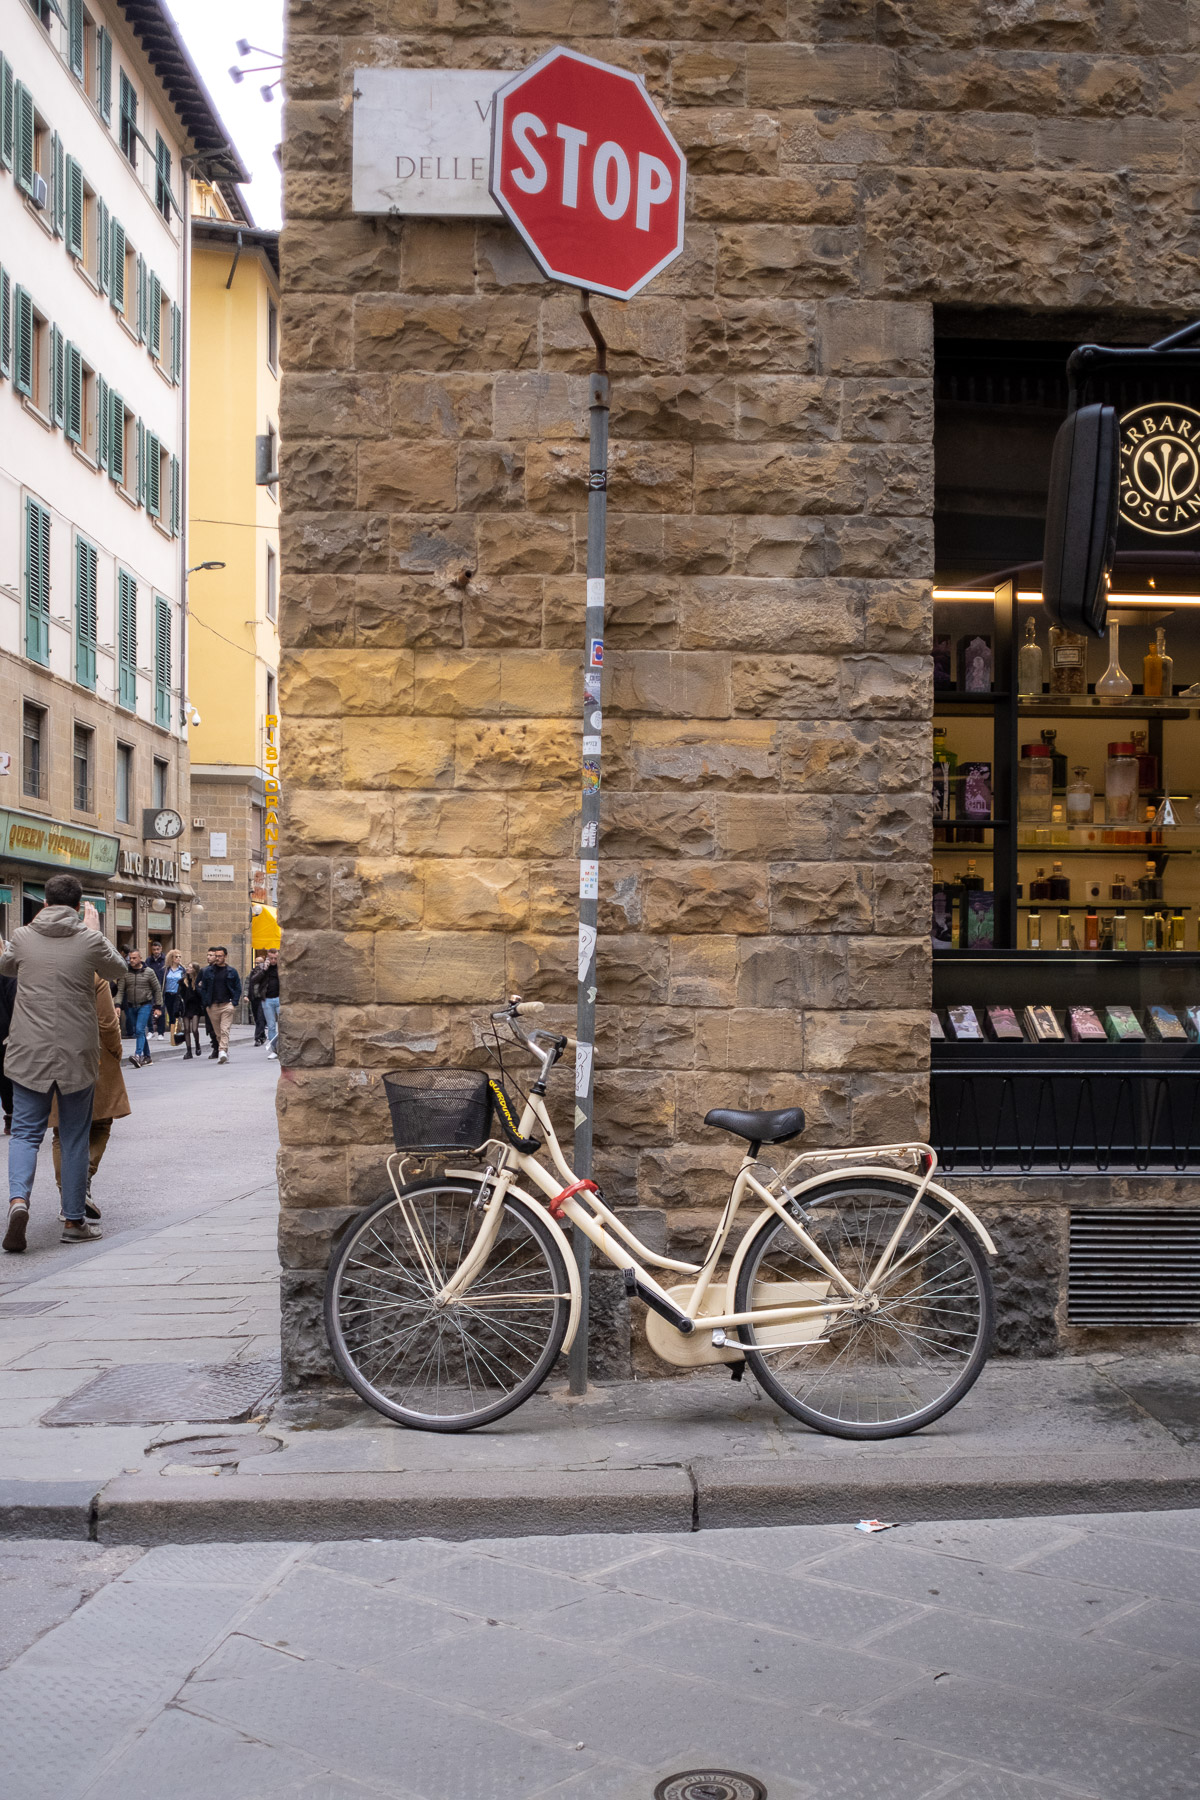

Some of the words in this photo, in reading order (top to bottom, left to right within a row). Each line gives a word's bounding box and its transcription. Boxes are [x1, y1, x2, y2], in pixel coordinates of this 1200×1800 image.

[395, 156, 485, 180] DELLE
[511, 111, 673, 232] STOP
[1121, 415, 1200, 456] ERBARI
[1120, 475, 1200, 523] TOSCAN
[265, 714, 279, 874] RISTORANTE
[9, 824, 45, 851] QUEEN
[47, 833, 91, 861] VICTORIA
